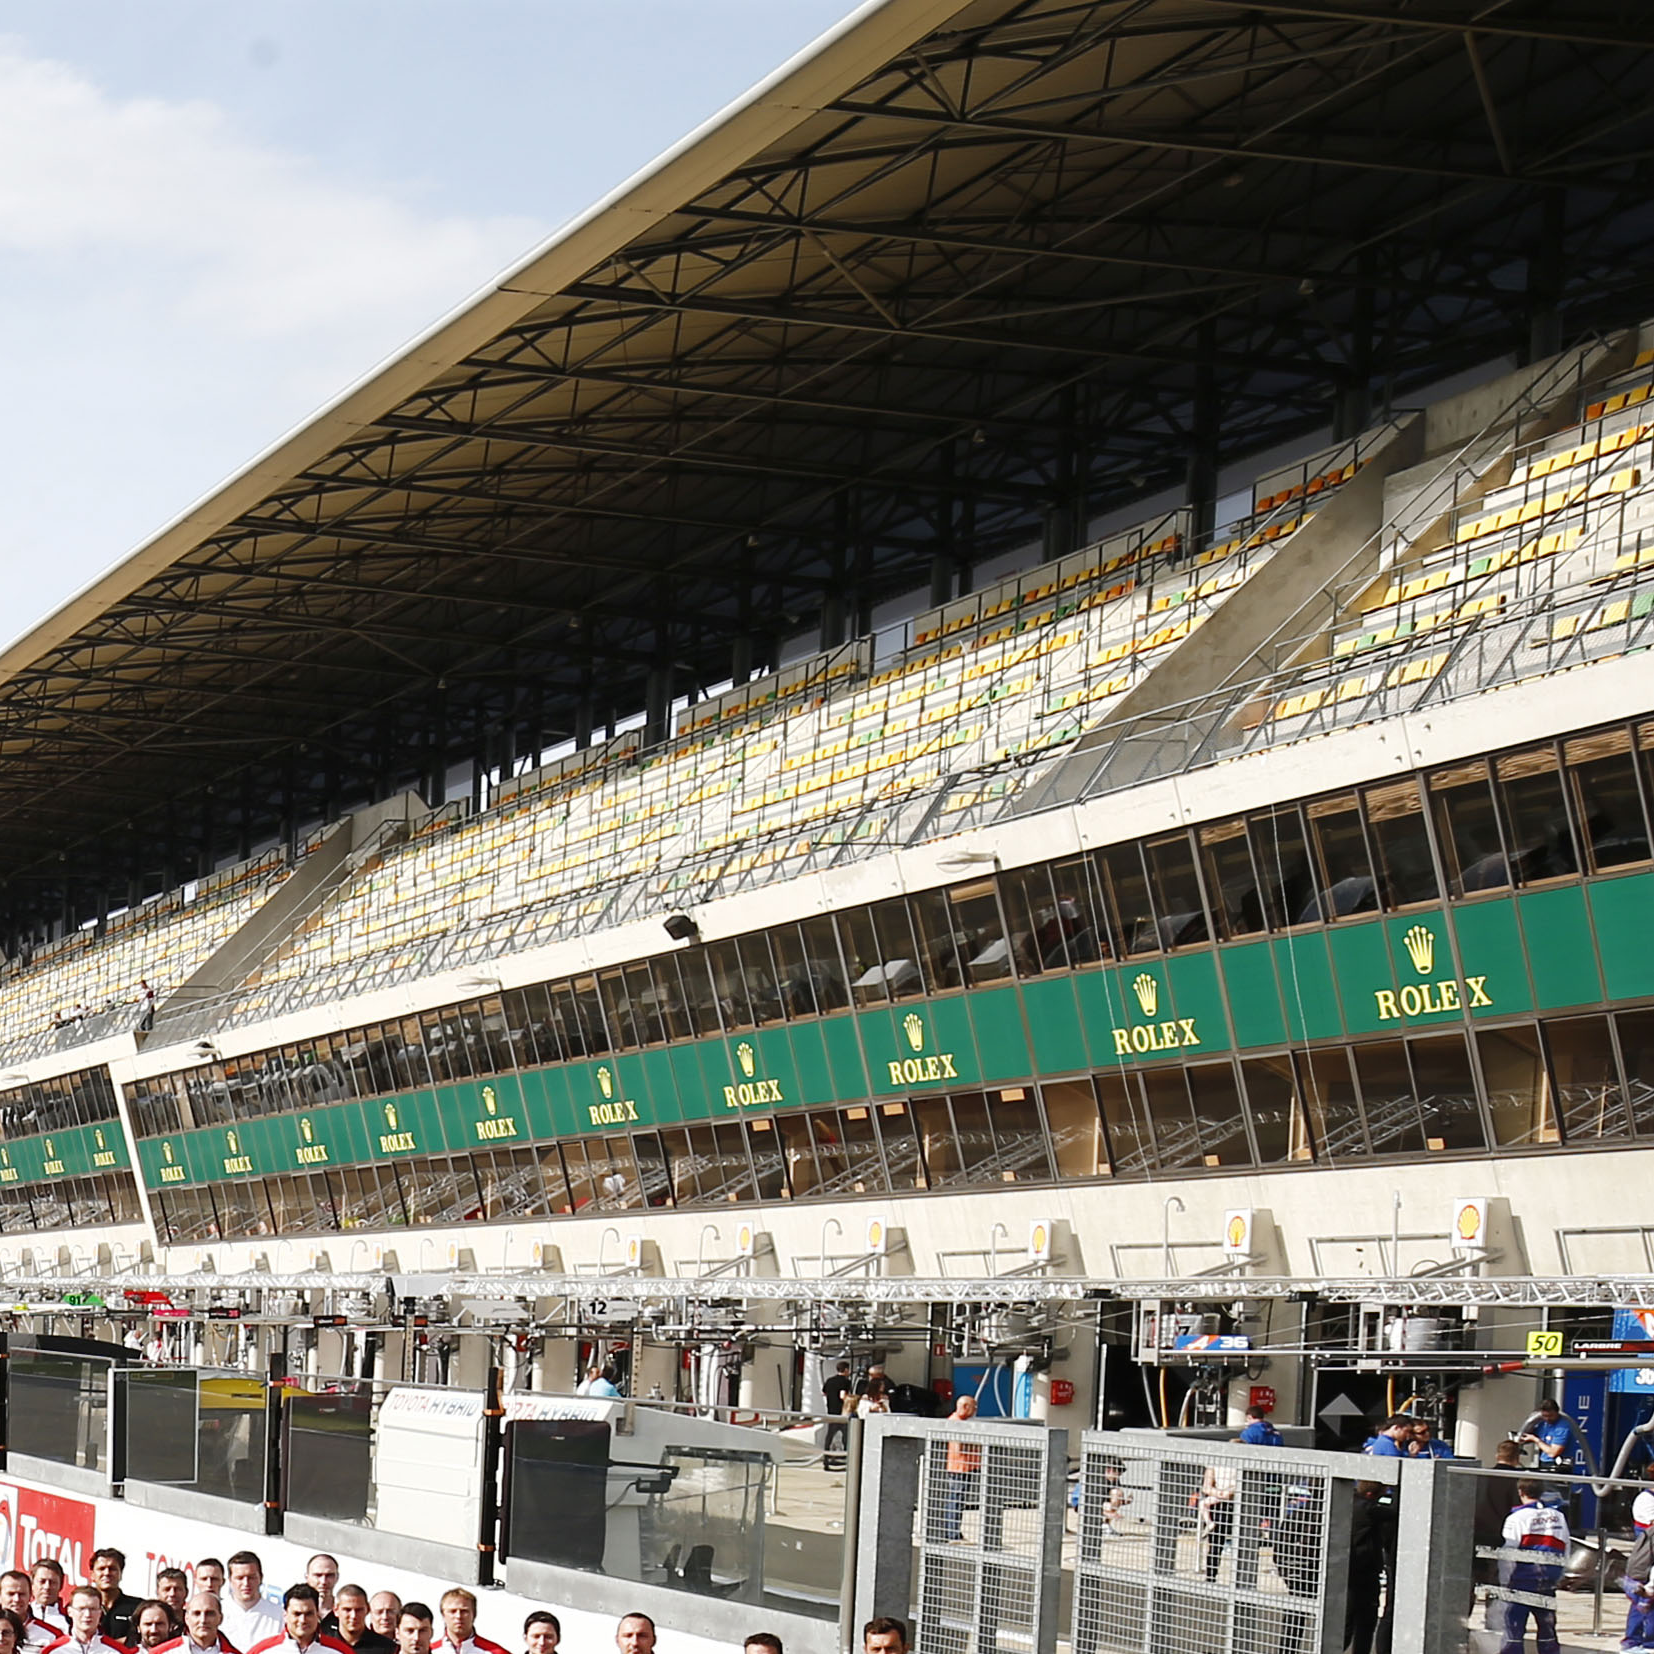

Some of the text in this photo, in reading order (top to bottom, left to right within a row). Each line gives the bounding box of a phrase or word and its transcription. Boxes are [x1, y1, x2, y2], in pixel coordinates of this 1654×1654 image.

[1374, 976, 1492, 1020] ROLEX
[1112, 1018, 1201, 1055] ROLEX
[888, 1053, 957, 1086] ROLEX
[723, 1078, 782, 1108] ROLEX
[589, 1100, 639, 1126] ROLEX
[476, 1118, 517, 1140] ROLEX
[380, 1132, 415, 1153] ROLEX
[69, 1295, 83, 1305] 91
[588, 1301, 607, 1316] 12
[1220, 1336, 1248, 1348] 36
[1532, 1336, 1558, 1351] 50
[431, 1398, 480, 1416] HYBRID
[20, 1513, 89, 1587] TOTAL
